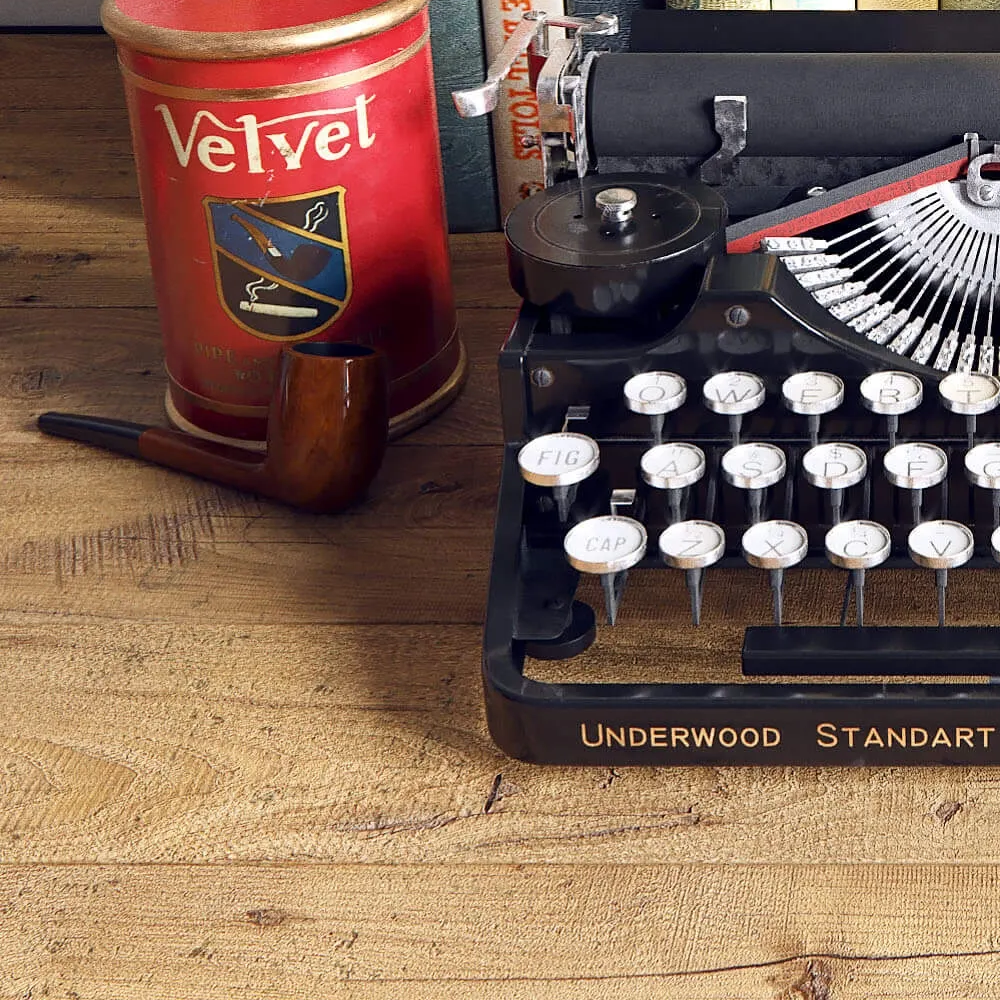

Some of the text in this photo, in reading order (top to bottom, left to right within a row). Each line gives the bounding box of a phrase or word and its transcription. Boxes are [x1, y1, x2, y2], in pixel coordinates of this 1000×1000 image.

[154, 94, 376, 174] Velvet
[714, 388, 752, 404] W
[801, 389, 822, 405] E
[956, 389, 981, 404] T
[537, 450, 580, 466] FIG
[656, 460, 680, 477] A
[741, 461, 763, 479] S
[824, 461, 849, 478] D
[907, 461, 928, 477] F
[586, 537, 627, 553] CAP
[675, 540, 703, 557] Z
[760, 540, 785, 557] X
[842, 540, 868, 557] C
[929, 540, 952, 556] V
[581, 723, 781, 748] UNDERWOOD
[816, 723, 996, 748] STANDART
